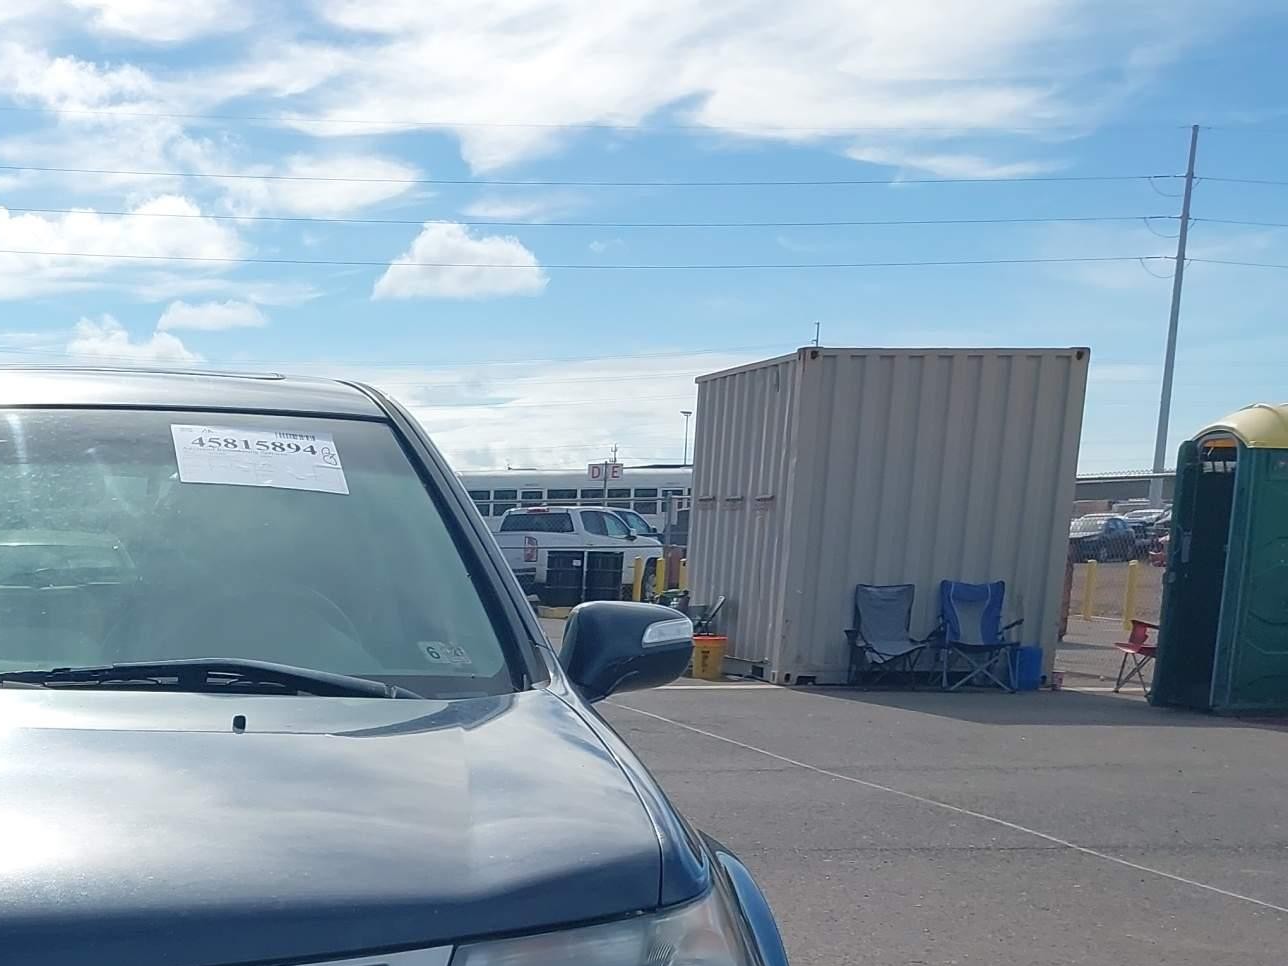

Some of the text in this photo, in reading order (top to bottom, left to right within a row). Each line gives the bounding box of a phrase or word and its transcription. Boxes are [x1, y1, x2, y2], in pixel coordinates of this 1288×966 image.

[191, 436, 317, 455] 45815894
[592, 466, 620, 478] D E
[426, 646, 440, 659] 6
